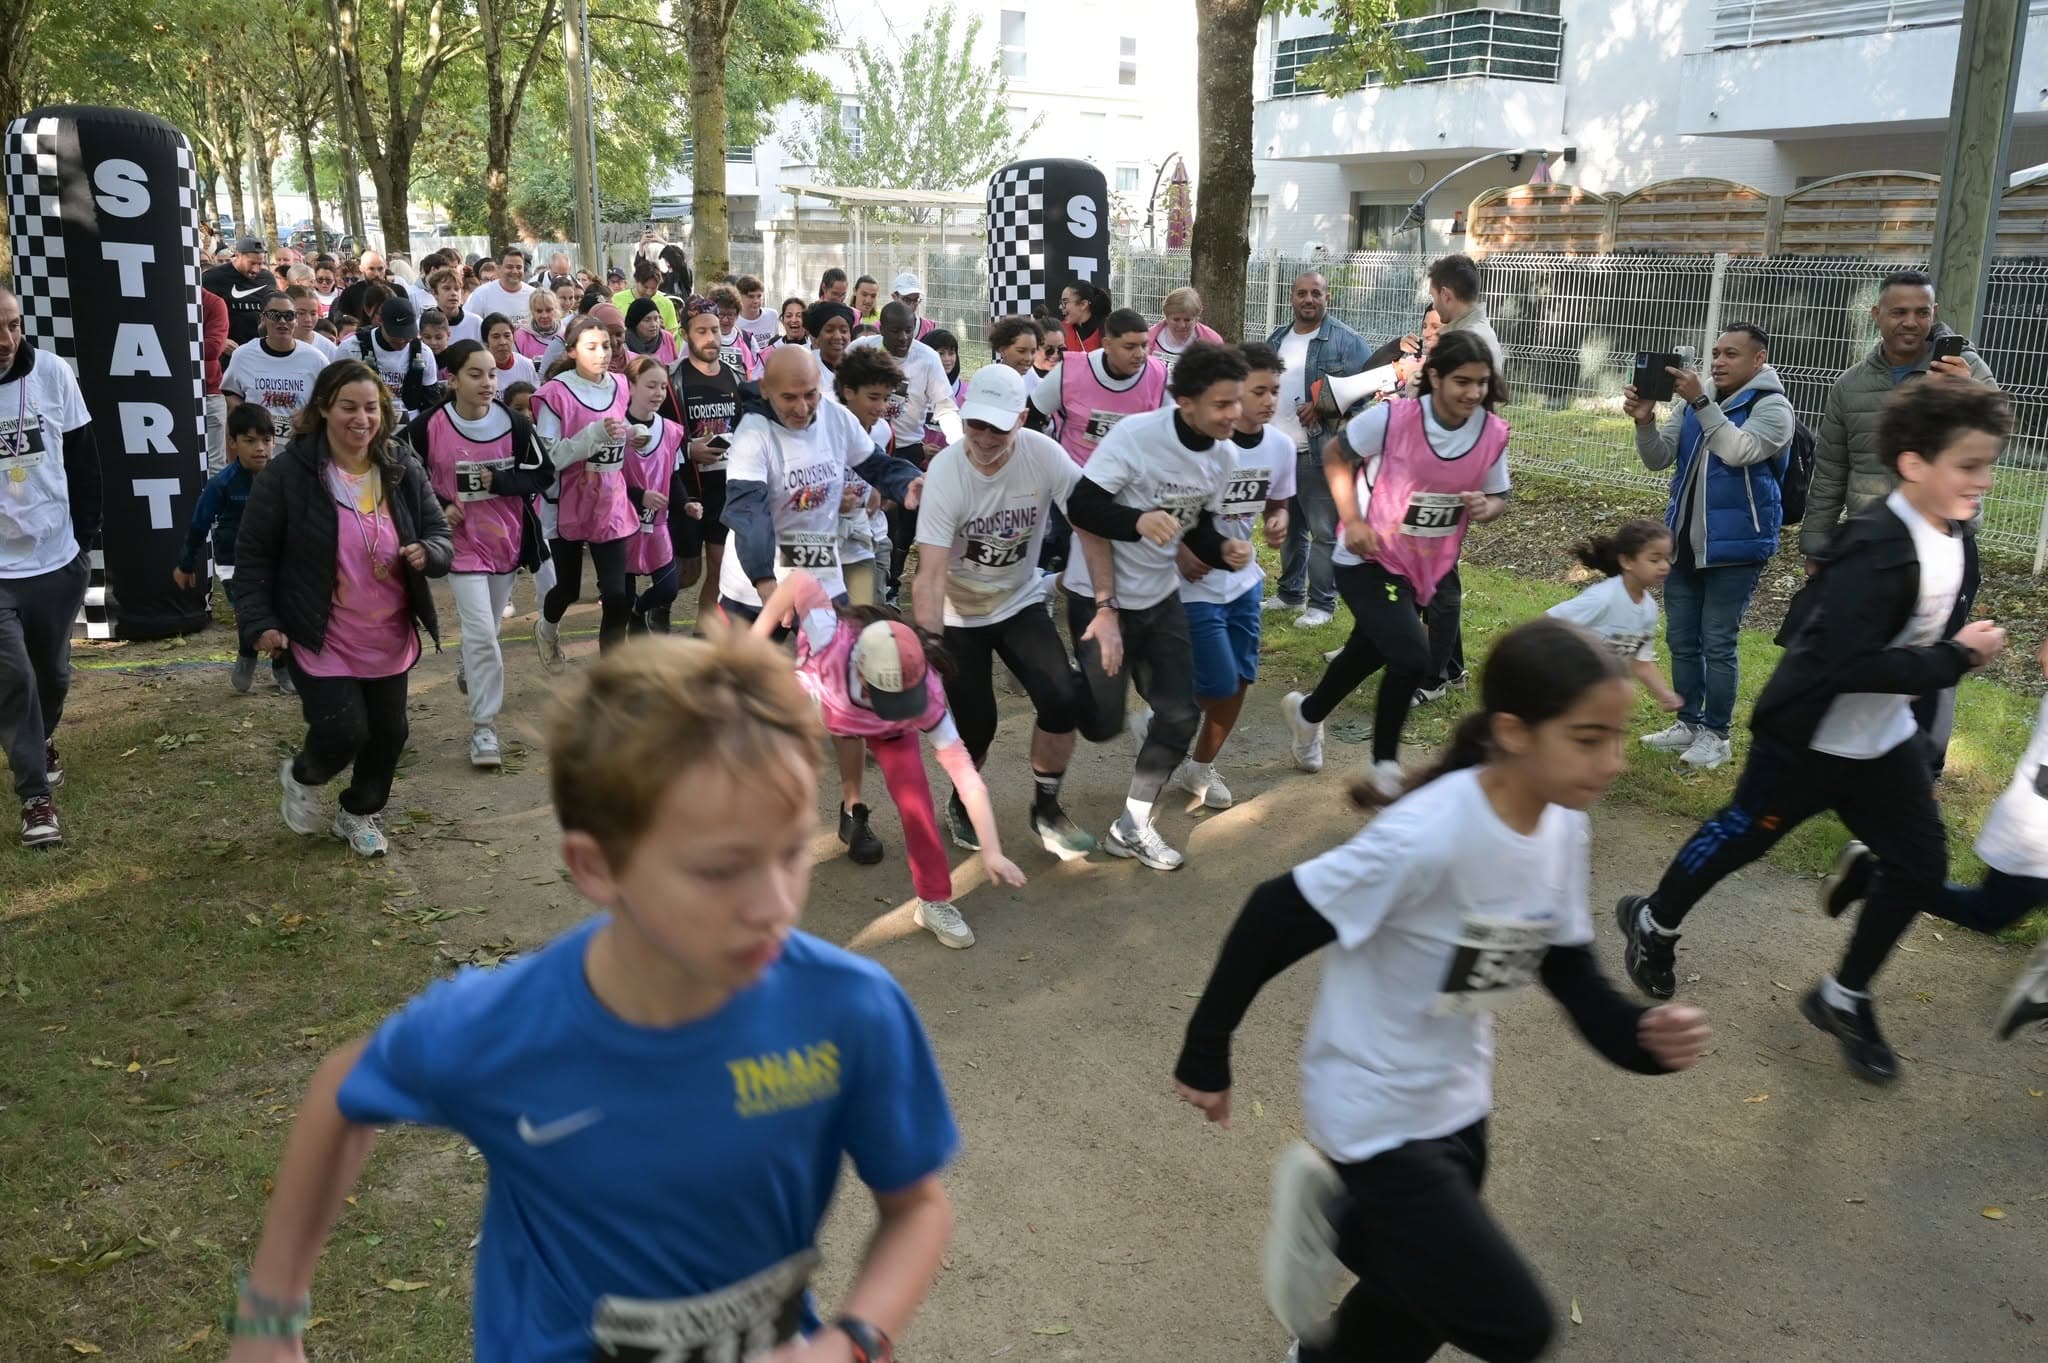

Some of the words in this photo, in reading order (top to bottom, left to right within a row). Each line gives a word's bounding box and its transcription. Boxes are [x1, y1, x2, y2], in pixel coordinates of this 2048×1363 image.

[93, 158, 181, 529] START
[254, 377, 304, 391] L'ORLYSIENNE
[688, 402, 736, 419] L'ORLYSIENNE
[1224, 481, 1261, 501] 449
[1416, 507, 1456, 526] 571
[793, 546, 831, 566] 375
